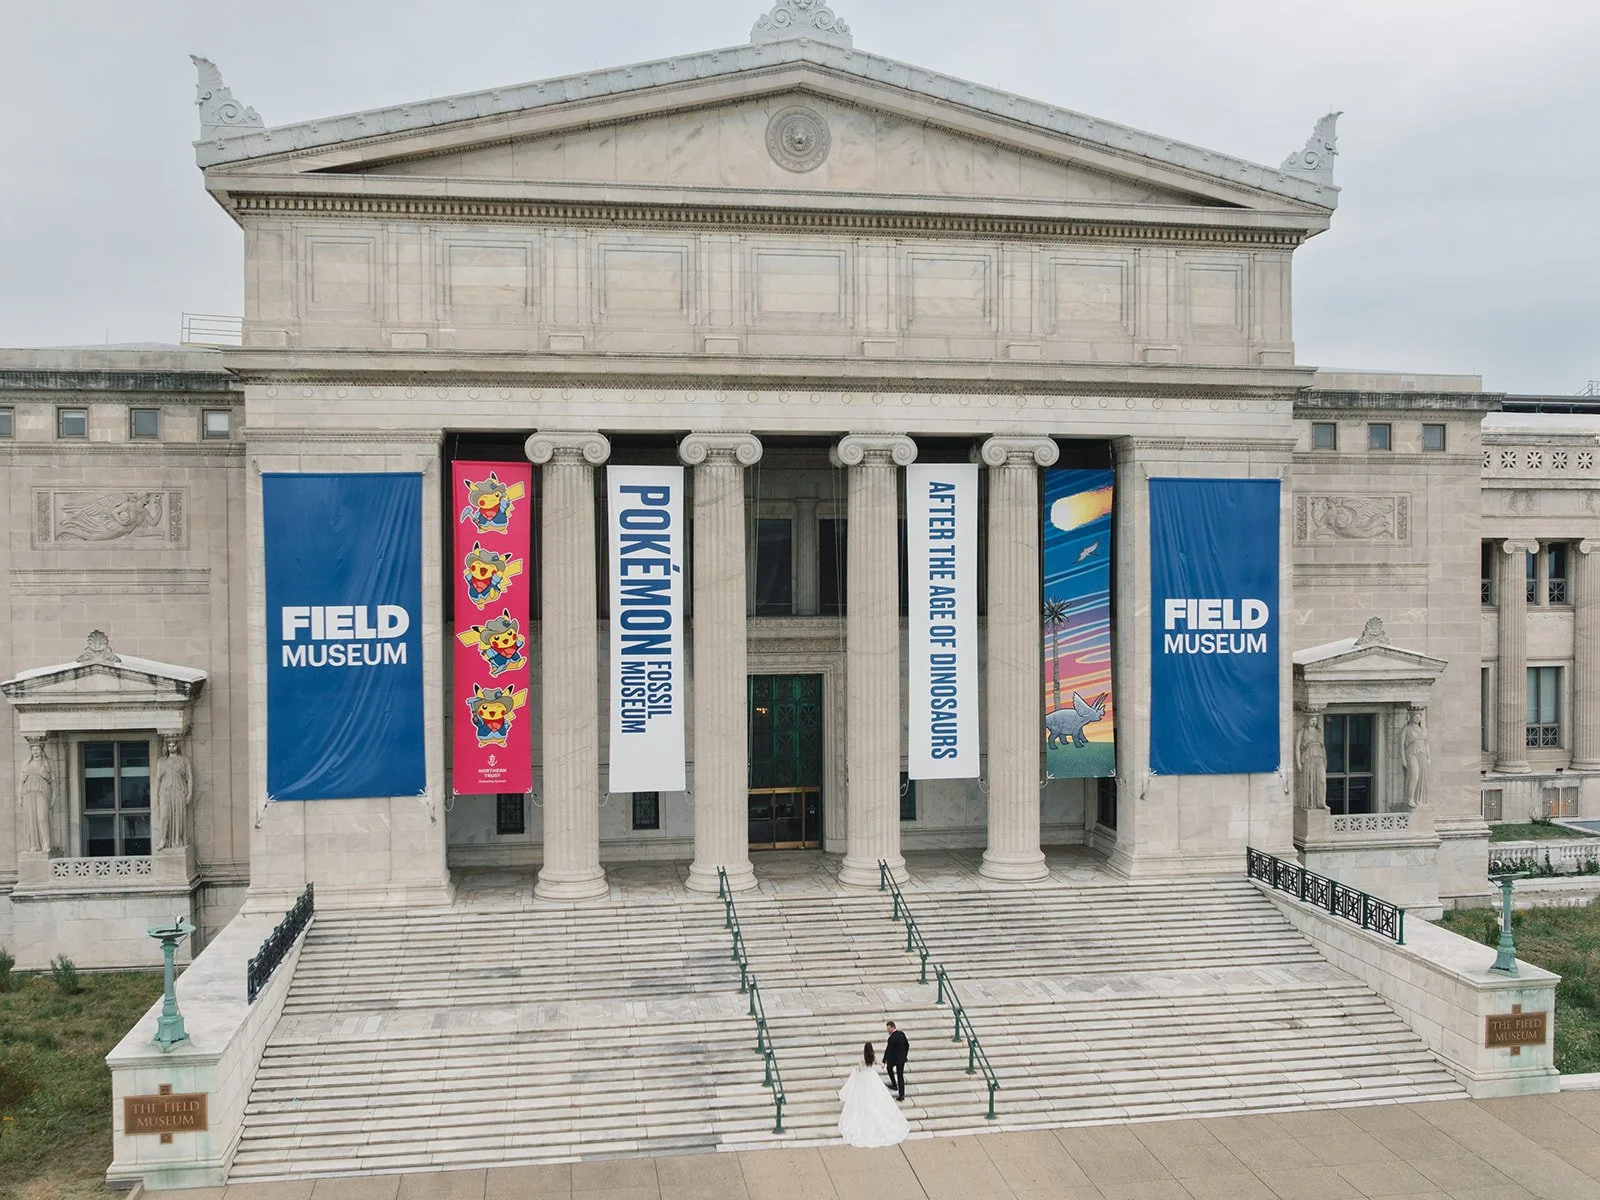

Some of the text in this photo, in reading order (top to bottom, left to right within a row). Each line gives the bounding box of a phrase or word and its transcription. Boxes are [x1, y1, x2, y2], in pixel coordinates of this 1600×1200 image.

[619, 485, 680, 655] POKÉMON
[281, 604, 410, 641] FIELD
[928, 481, 958, 760] AFTER THE AGE OF DINOSAURS
[1164, 598, 1269, 630] FIELD
[281, 642, 407, 667] MUSEUM
[1164, 633, 1267, 654] MUSEUM
[620, 661, 647, 734] MUSEUM
[647, 661, 672, 719] FOSSIL
[1492, 1018, 1542, 1030] THE FIELD
[1495, 1031, 1538, 1041] MUSEUM
[132, 1101, 200, 1114] THE FIELD
[137, 1114, 194, 1128] MUSEUM
